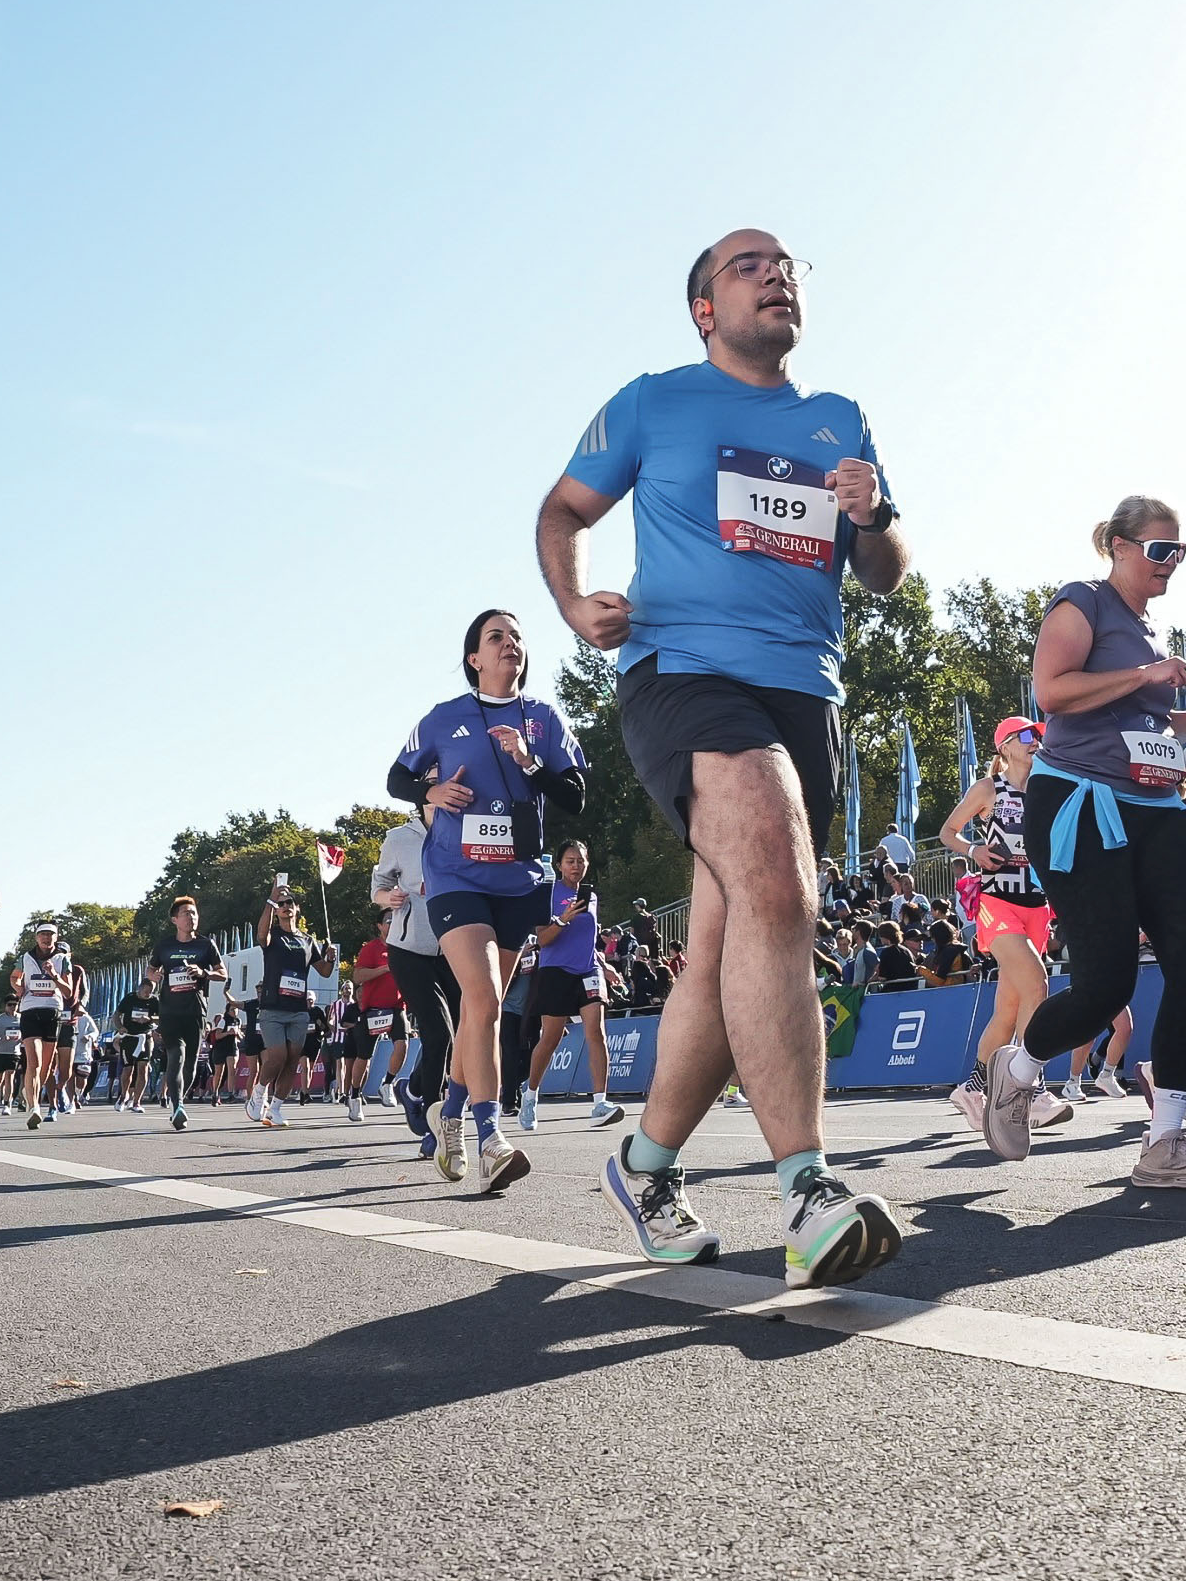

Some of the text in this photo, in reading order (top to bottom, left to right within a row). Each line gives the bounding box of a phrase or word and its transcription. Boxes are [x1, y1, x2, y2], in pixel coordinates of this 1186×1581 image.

[749, 493, 807, 520] 1189
[756, 528, 820, 555] GENERALI
[1138, 741, 1176, 760] 10079
[482, 846, 515, 855] GENERA
[887, 1054, 916, 1066] Abbott
